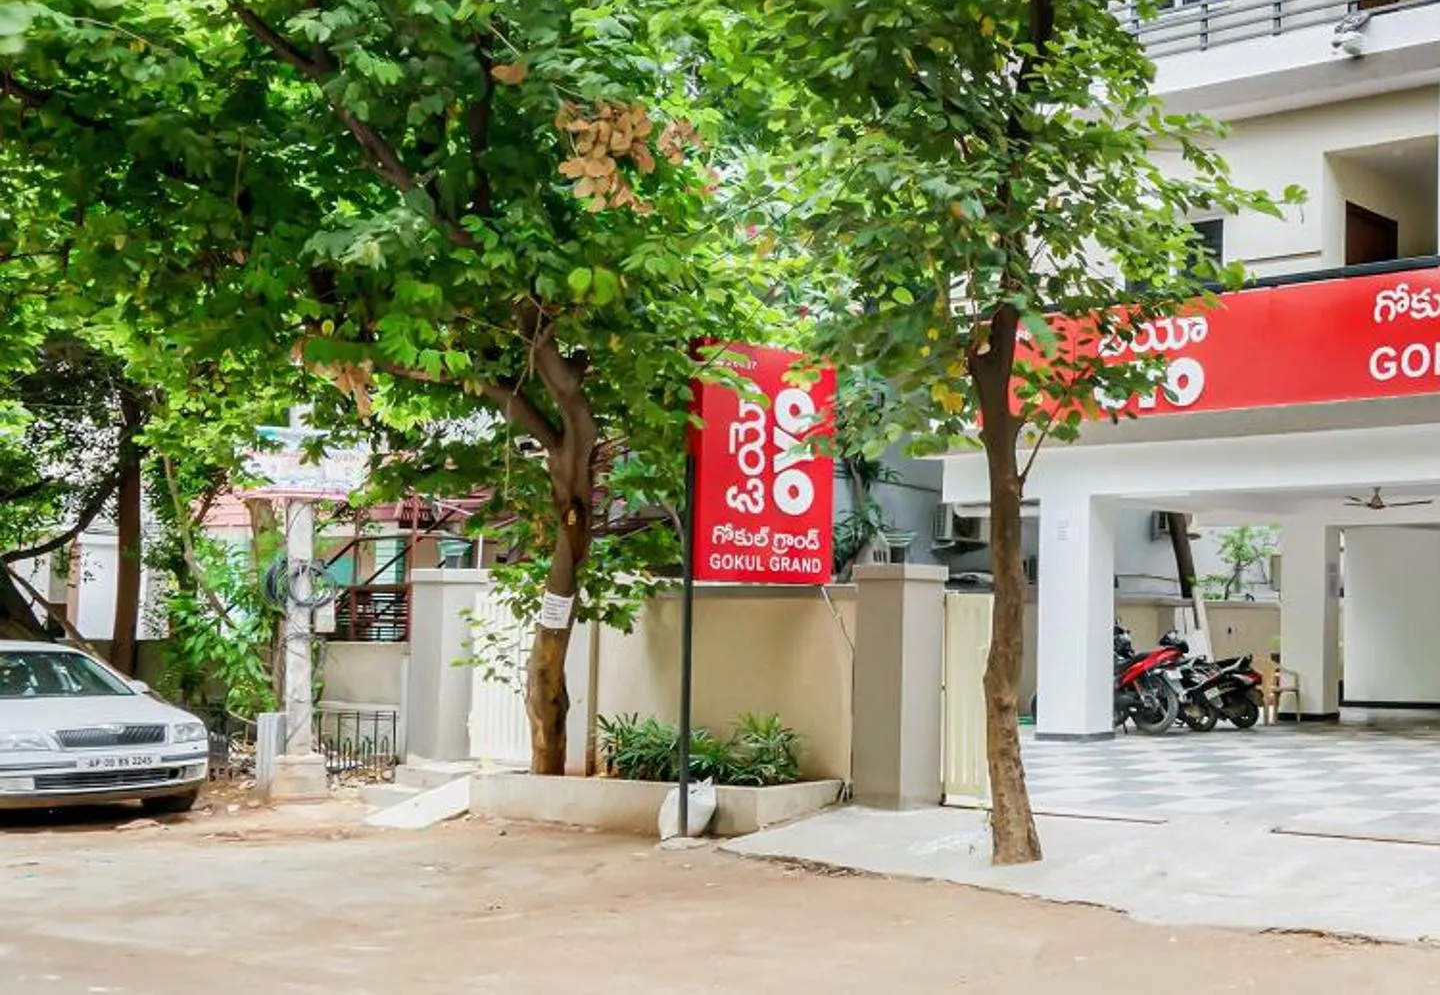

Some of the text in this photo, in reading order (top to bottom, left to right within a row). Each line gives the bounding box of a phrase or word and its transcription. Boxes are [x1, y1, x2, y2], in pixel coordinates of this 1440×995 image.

[773, 388, 815, 516] OYO
[709, 553, 822, 574] GOKUL GRAND
